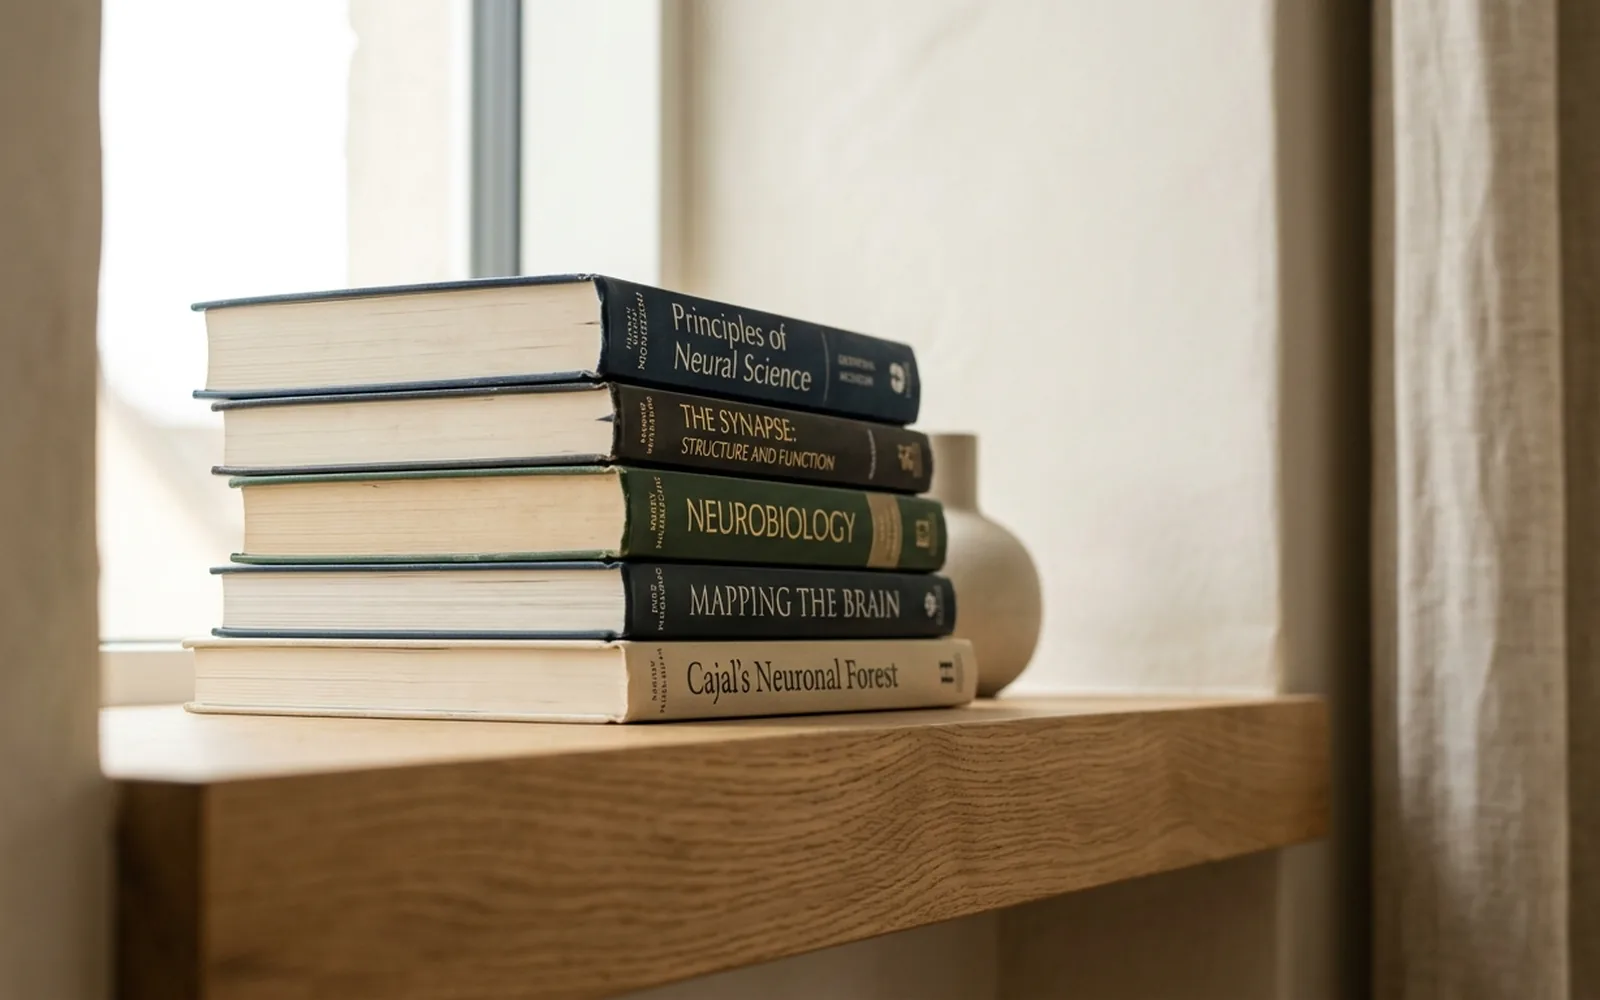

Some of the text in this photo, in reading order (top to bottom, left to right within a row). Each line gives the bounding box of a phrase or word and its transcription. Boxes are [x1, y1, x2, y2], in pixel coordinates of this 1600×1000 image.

[671, 302, 765, 350] Principles
[769, 322, 787, 351] of
[674, 340, 738, 379] Neural
[743, 352, 813, 391] Science
[679, 403, 716, 432] THE
[719, 408, 797, 442] SYNAPSE:
[681, 436, 836, 472] STRUCTURE AND FUNCTION
[686, 497, 856, 543] NEUROBIOLOGY
[689, 583, 792, 618] MAPPING
[796, 586, 838, 618] THE
[843, 587, 901, 619] BRAIN
[754, 657, 842, 693] Neuronal
[845, 659, 899, 690] Forest
